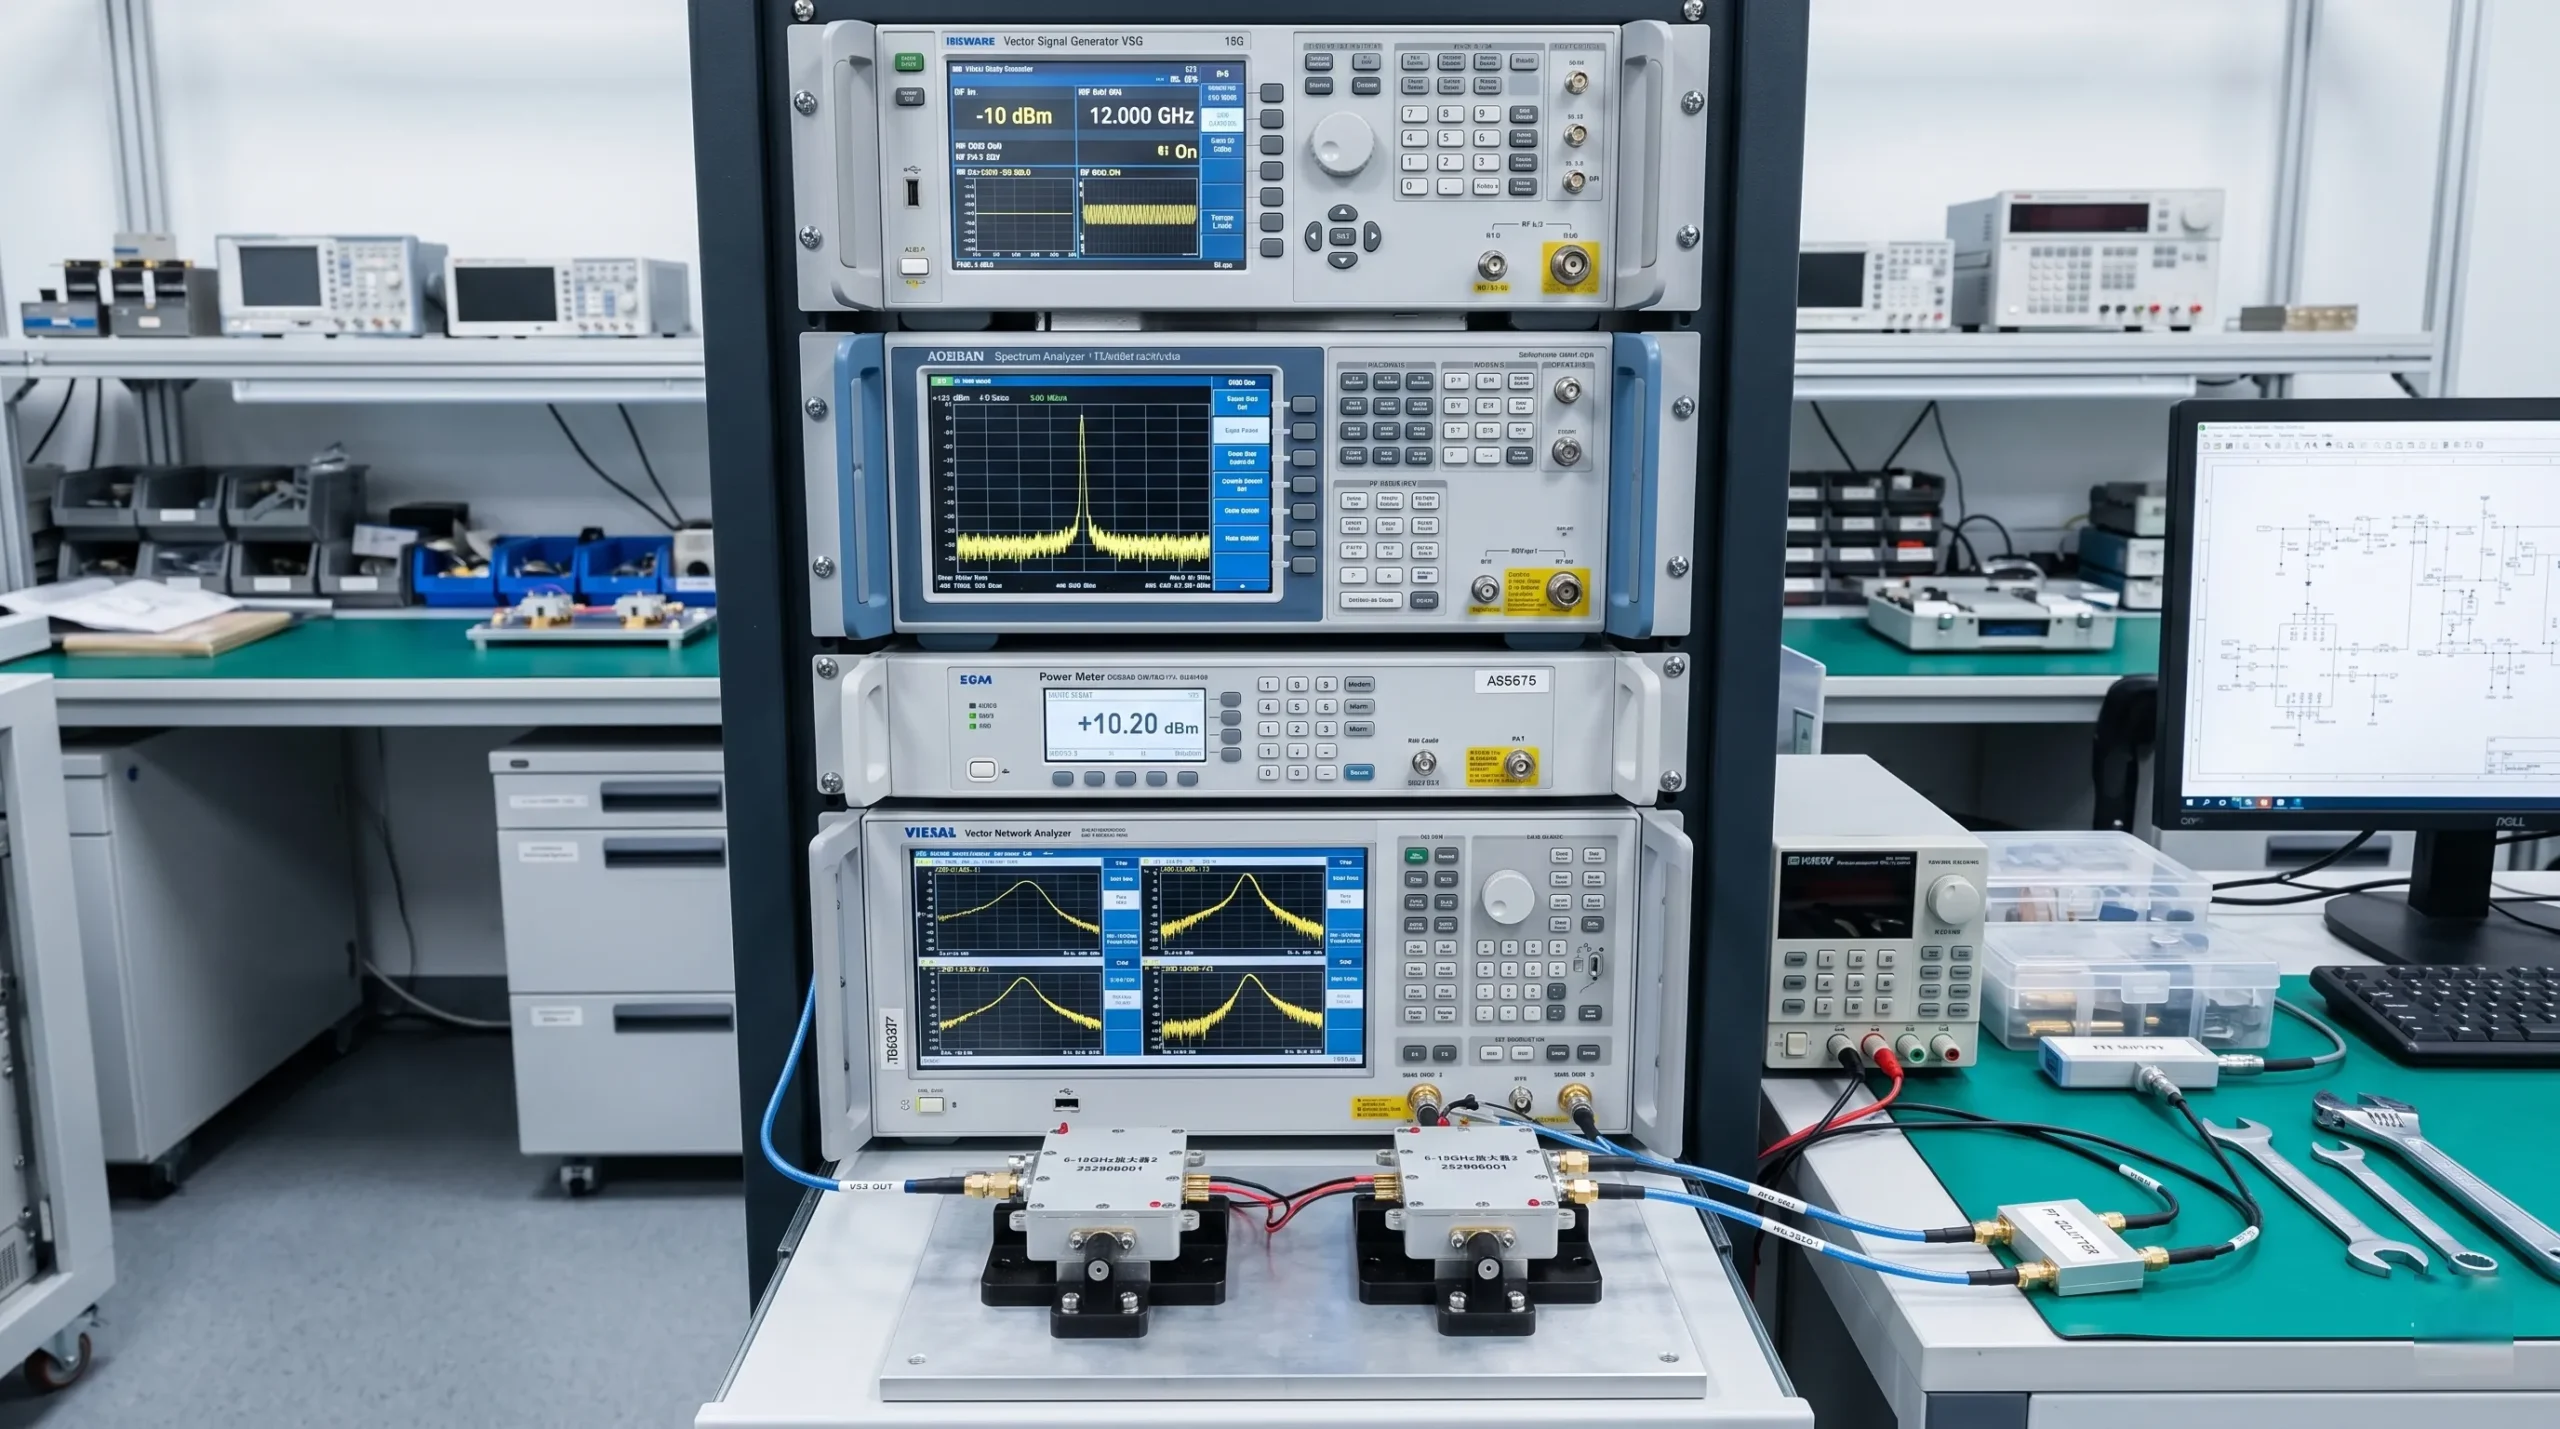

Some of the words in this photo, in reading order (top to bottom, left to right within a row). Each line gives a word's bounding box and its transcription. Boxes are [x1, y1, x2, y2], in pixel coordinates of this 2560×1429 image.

[1004, 36, 1034, 47] Vector
[1037, 36, 1067, 49] Signal
[1070, 36, 1118, 47] Generator
[1121, 36, 1143, 47] VSG
[976, 107, 1007, 126] -10
[1012, 106, 1052, 126] dBm
[1090, 106, 1152, 126] 12.000
[1158, 106, 1195, 126] GHz
[1175, 144, 1198, 159] On
[995, 351, 1041, 363] Spectrum
[1043, 351, 1085, 363] Analyzer
[1039, 672, 1073, 682] Power
[1075, 672, 1105, 682] Meter
[1486, 675, 1537, 687] AS5675
[1078, 712, 1158, 735] +10.20
[1164, 721, 1199, 735] dBm
[965, 829, 992, 838] Vector
[994, 829, 1032, 838] Network
[1034, 829, 1072, 840] Analyzer
